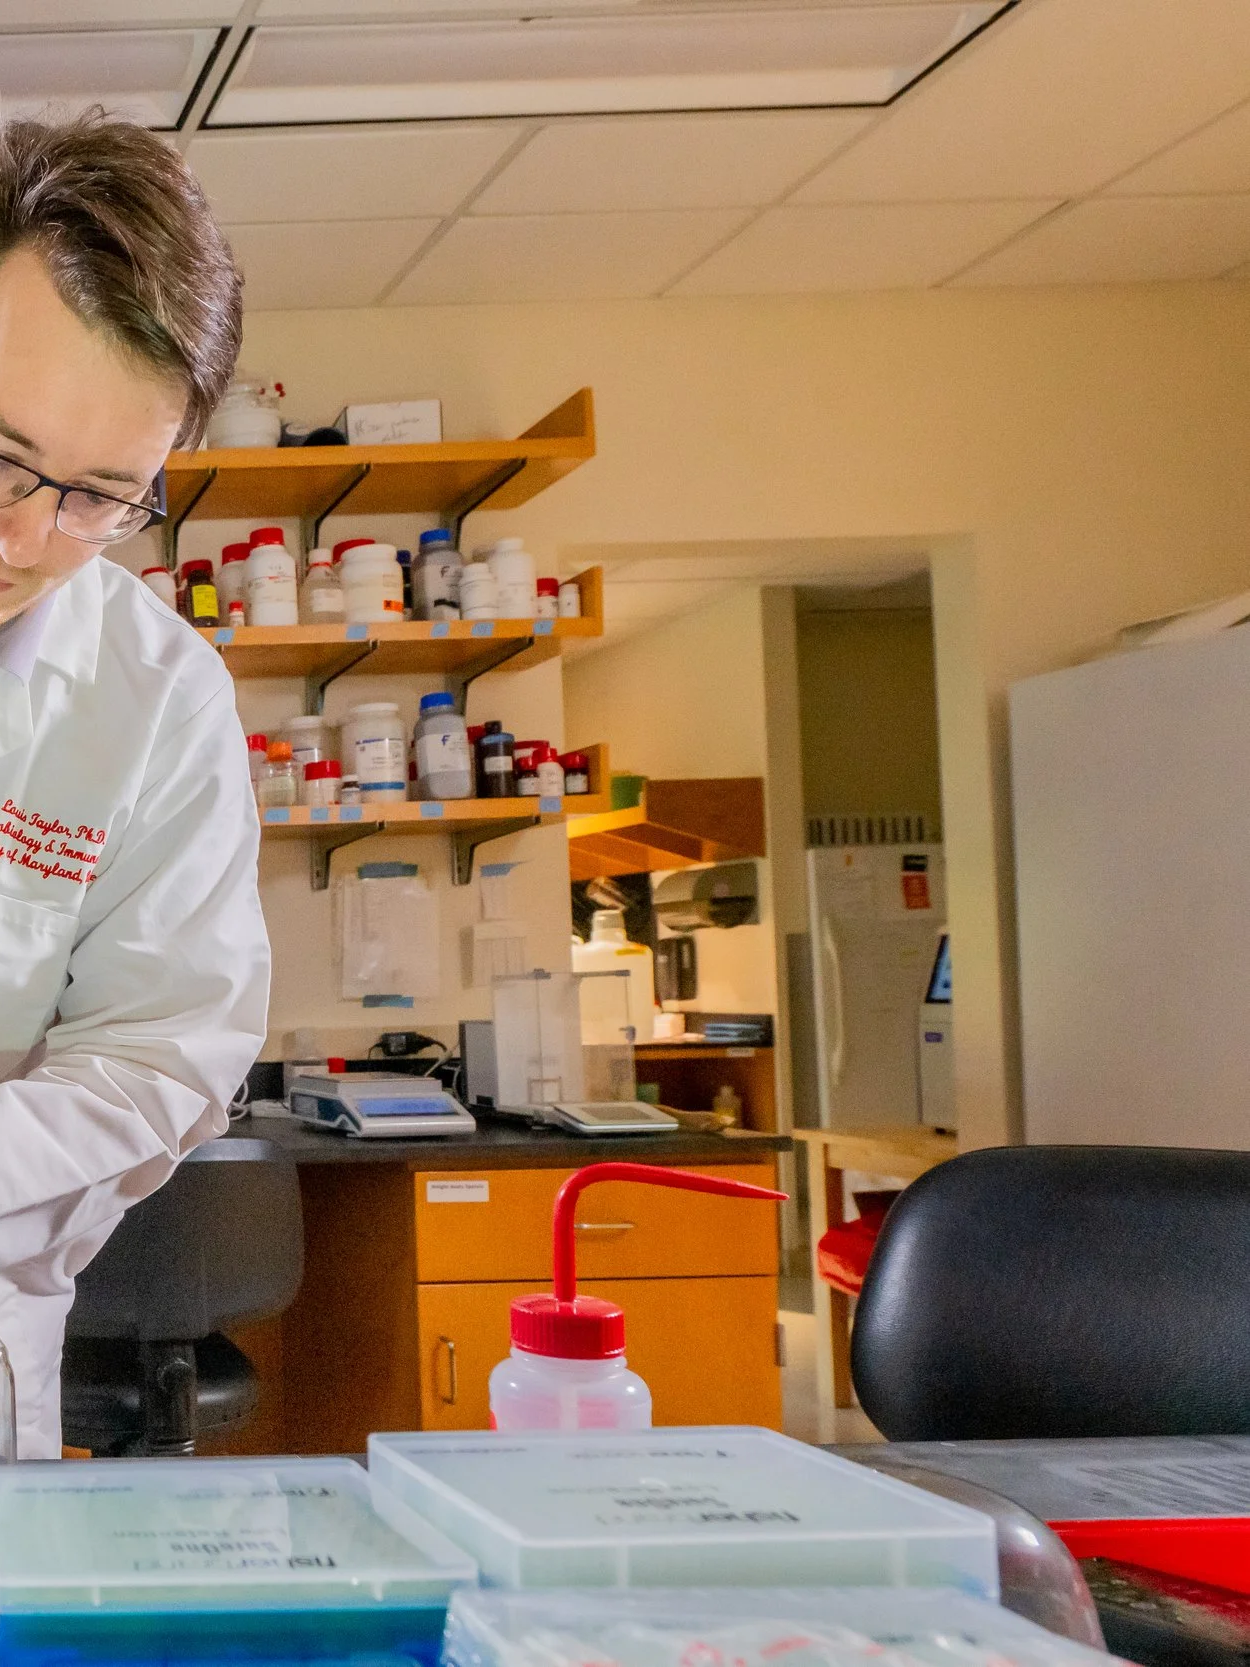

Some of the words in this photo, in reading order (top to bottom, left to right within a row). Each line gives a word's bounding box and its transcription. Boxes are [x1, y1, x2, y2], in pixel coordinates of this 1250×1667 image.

[1, 799, 27, 823] Louis
[29, 813, 71, 839] Taylor,
[6, 849, 18, 864] of
[17, 853, 83, 885] Maryland,
[56, 842, 100, 864] Immun
